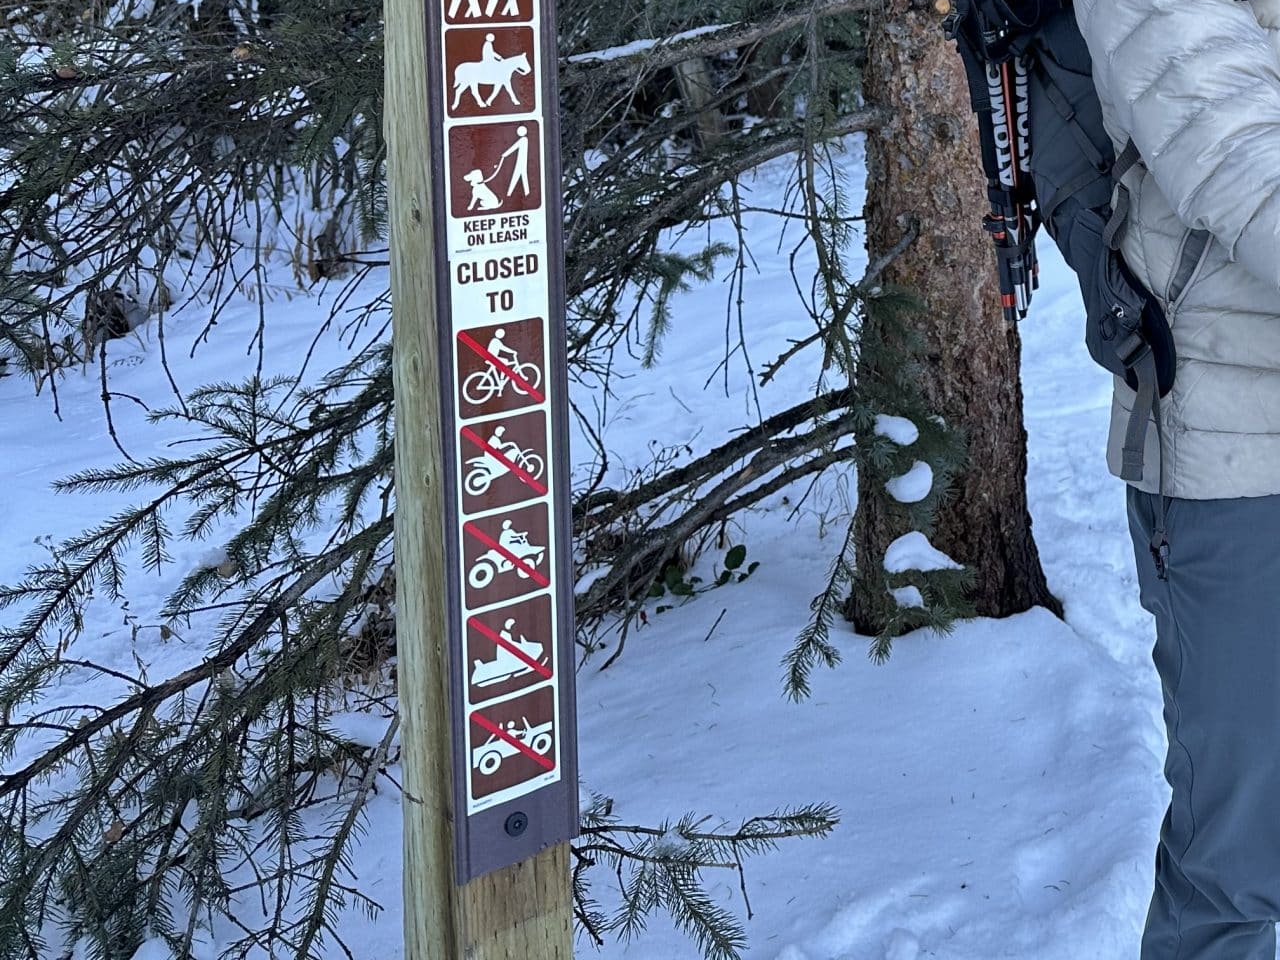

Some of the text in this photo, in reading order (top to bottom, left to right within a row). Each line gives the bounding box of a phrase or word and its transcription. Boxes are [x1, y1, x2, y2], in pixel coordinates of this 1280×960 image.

[985, 63, 1014, 187] ATOMIC
[464, 214, 530, 233] KEEP PETS
[467, 228, 528, 247] ON LEASH
[457, 253, 539, 285] CLOSED
[486, 289, 514, 313] TO
